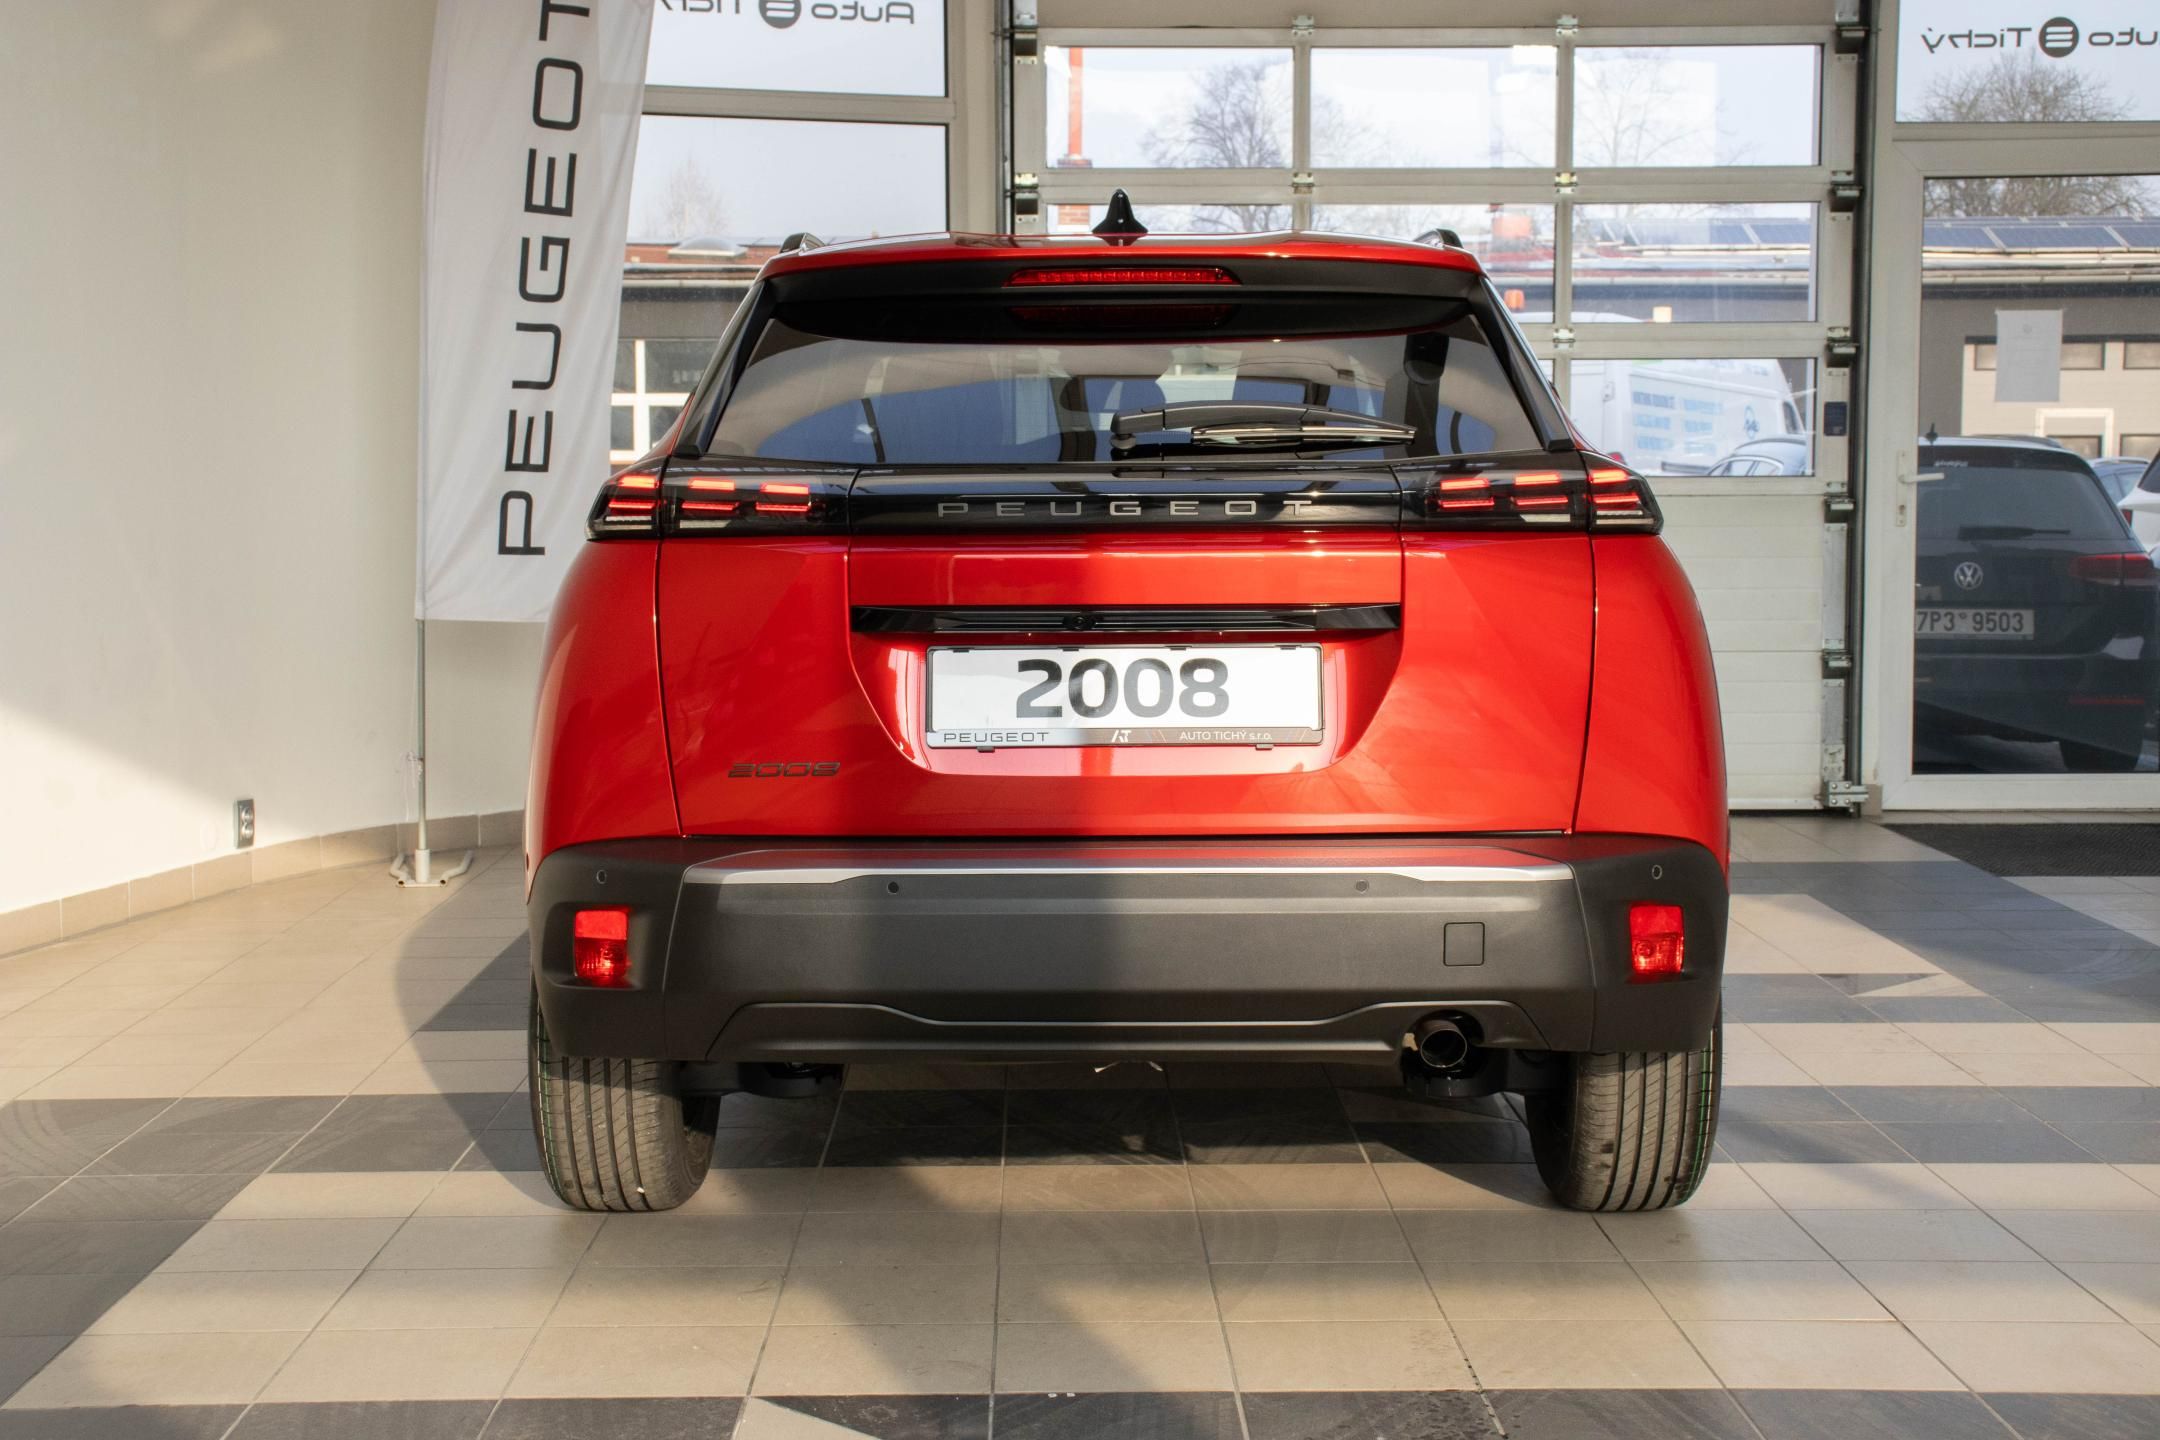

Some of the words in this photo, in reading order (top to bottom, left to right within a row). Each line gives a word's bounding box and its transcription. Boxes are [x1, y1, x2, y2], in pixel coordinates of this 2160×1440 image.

[497, 0, 590, 557] PEUGEOT
[937, 499, 1313, 518] PEUGEOT
[1916, 610, 1955, 632] 7P3
[1972, 611, 2025, 633] 9503
[1015, 657, 1230, 718] 2008
[943, 731, 1050, 743] PEUGEOT
[1180, 731, 1212, 741] AUTO
[727, 761, 841, 778] 2008
